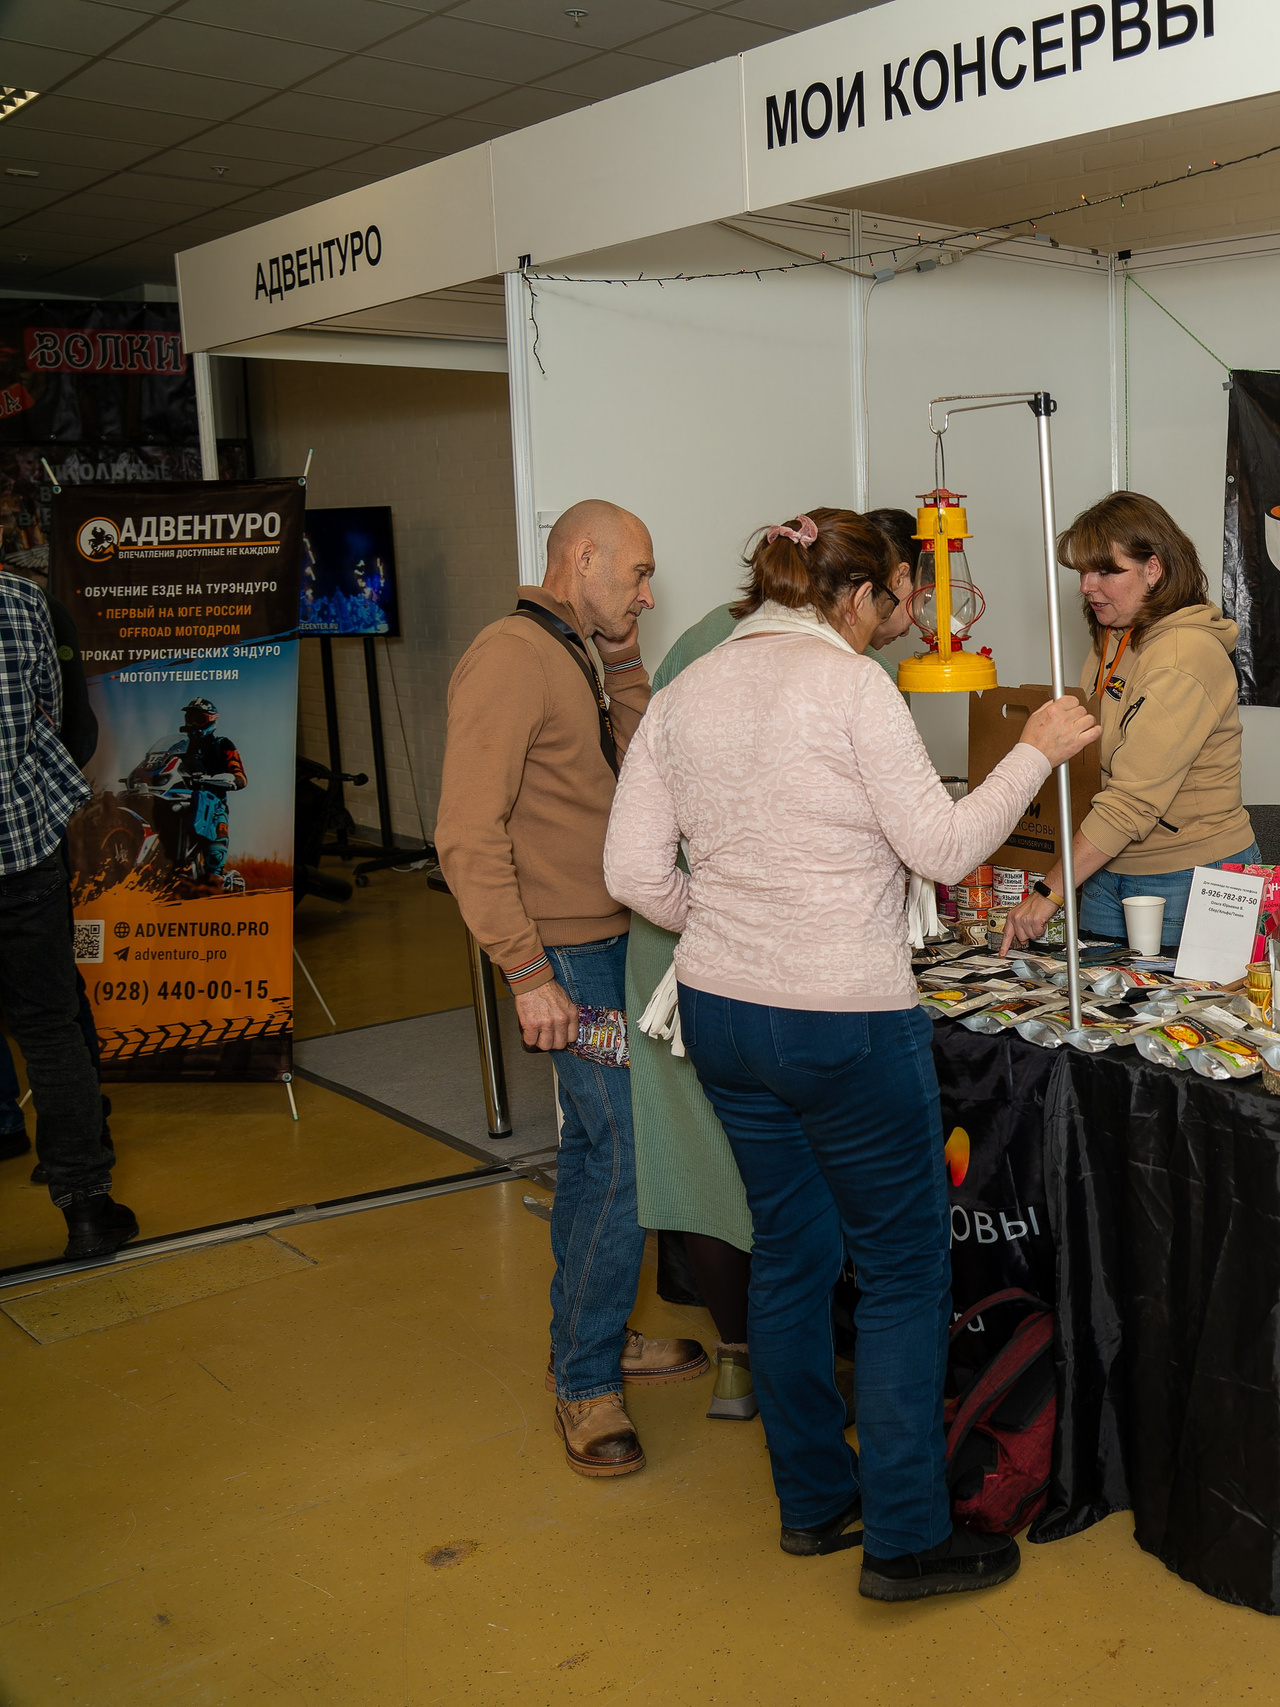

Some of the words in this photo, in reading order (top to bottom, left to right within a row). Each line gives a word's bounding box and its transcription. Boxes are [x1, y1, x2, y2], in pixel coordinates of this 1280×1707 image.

[766, 70, 866, 150] МОИ
[883, 0, 1215, 121] КОНСЕРВЫ
[254, 225, 382, 304] АДВЕНТУРО
[29, 331, 184, 372] ВОЛКИ
[120, 512, 282, 546] АДВЕНТУРО
[118, 549, 175, 559] ВПЕЧАТЛЕНИЯ
[176, 548, 225, 559] ДОСТУПНЫЕ
[226, 547, 238, 556] НЕ
[239, 546, 281, 556] КАЖДОМУ
[84, 585, 148, 598] ОБУЧЕНИЕ
[152, 584, 183, 597] ЕЗДЕ
[186, 583, 203, 595] НА
[206, 581, 278, 595] ТУРЭНДУРО
[106, 605, 155, 619] ПЕРВЫЙ
[158, 606, 174, 618] НА
[178, 606, 202, 617] ЮГЕ
[205, 605, 252, 617] РОССИИ
[119, 626, 172, 638] OFFROAD
[175, 624, 241, 638] МОТОДРОМ
[128, 647, 229, 661] ТУРИСТИЧЕСКИХ
[232, 645, 281, 659] ЭНДУРО
[119, 669, 239, 683] МОТОПУТЕШЕСТВИЯ
[1201, 888, 1258, 905] 8-926-782-87-50
[134, 921, 270, 938] ADVENTURO.PRO
[134, 949, 227, 962] adventuro_pro
[93, 981, 149, 1006] (928)
[157, 980, 269, 1000] 440-00-15
